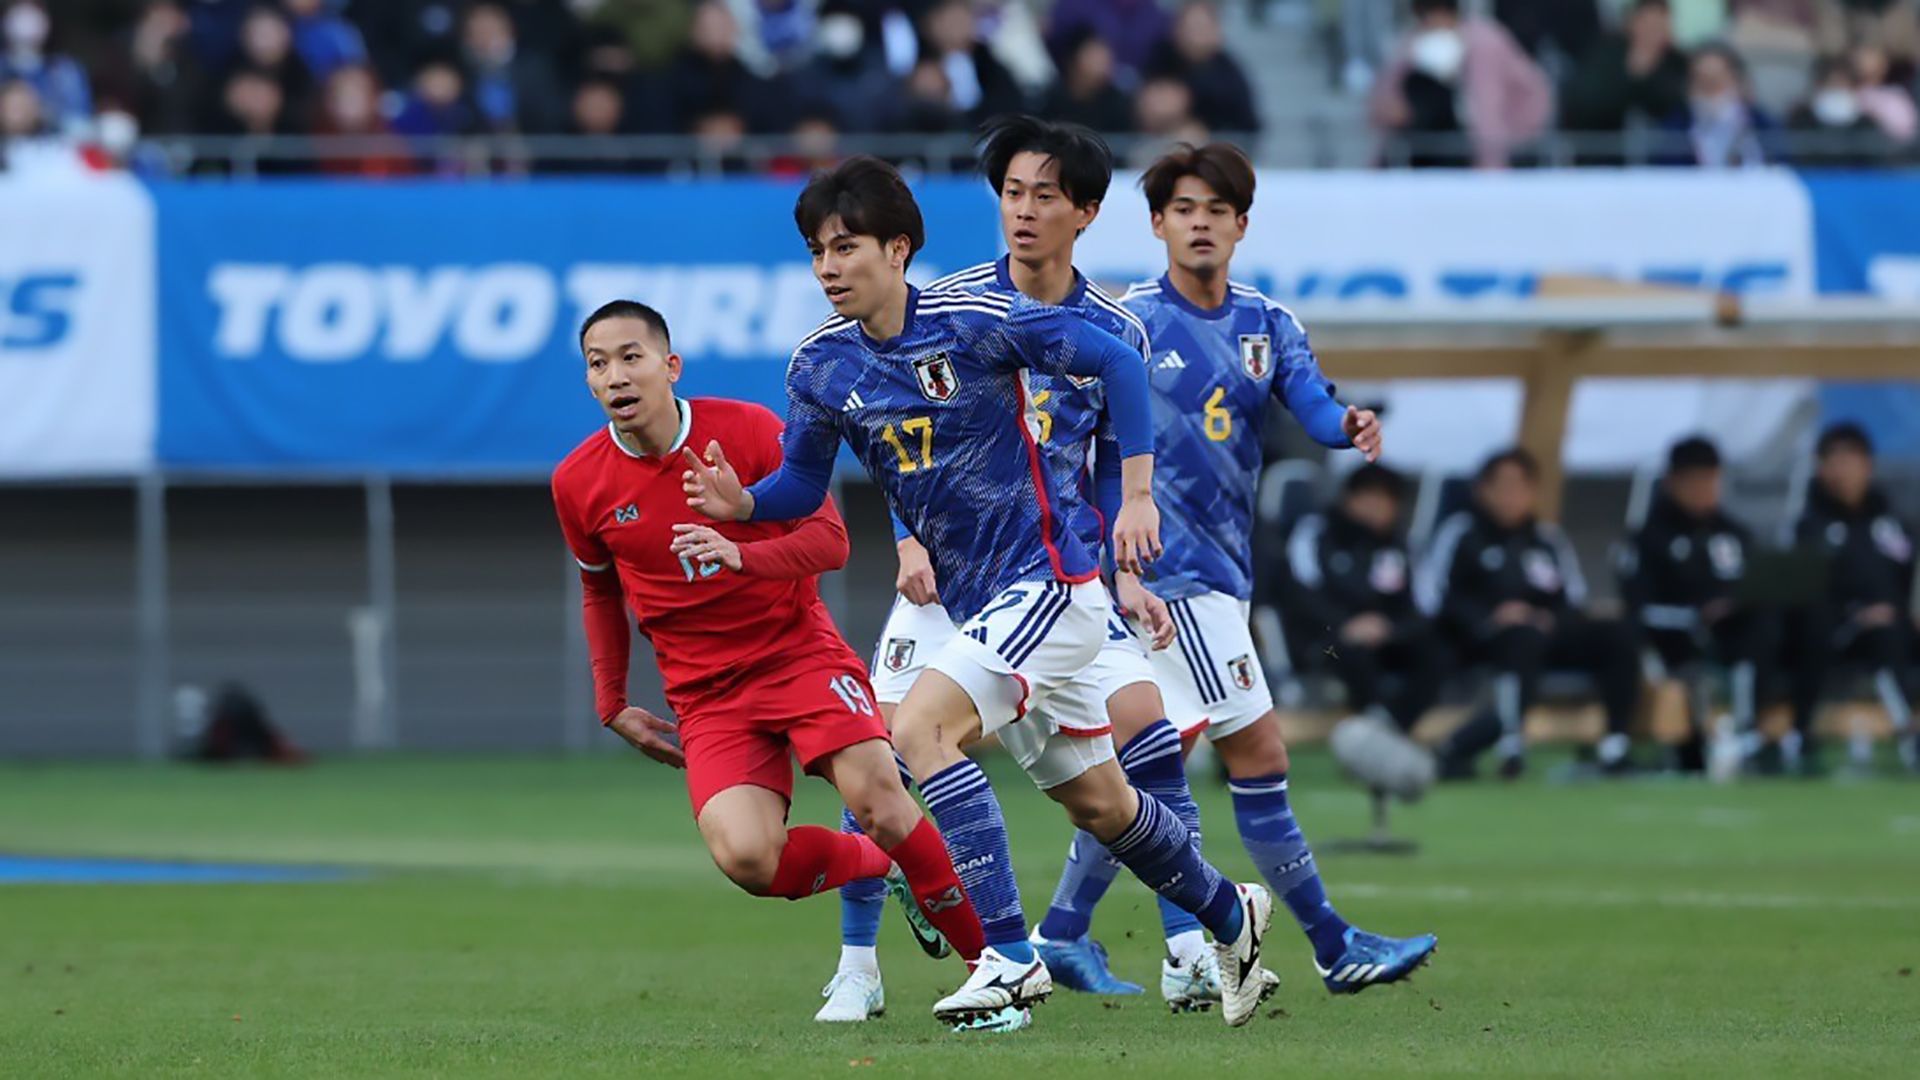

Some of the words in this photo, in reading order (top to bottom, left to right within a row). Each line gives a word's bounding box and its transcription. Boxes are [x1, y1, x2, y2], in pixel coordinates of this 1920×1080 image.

[0, 271, 80, 350] S
[208, 262, 559, 362] TOYO
[564, 262, 942, 359] TIRE
[1204, 386, 1232, 441] 6
[881, 416, 933, 472] 17
[829, 674, 874, 717] 19
